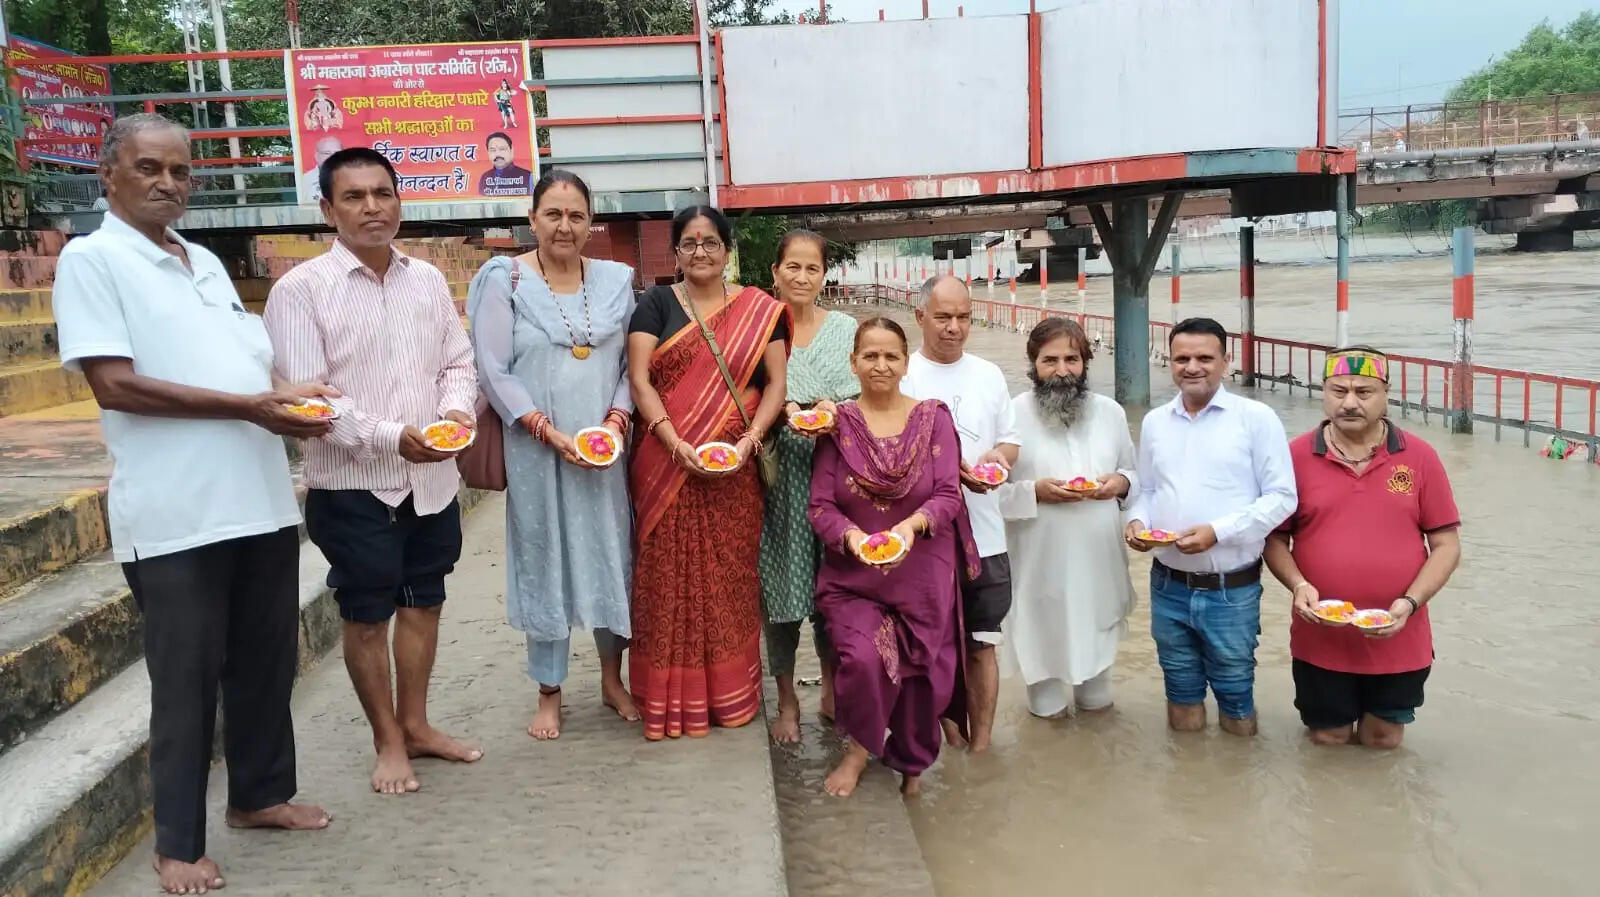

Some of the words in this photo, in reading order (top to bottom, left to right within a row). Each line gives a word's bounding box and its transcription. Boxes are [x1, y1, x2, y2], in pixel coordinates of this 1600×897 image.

[300, 63, 316, 80] श्री
[318, 66, 366, 80] महाराजा
[368, 60, 413, 78] अग्रसेन
[415, 62, 436, 76] घाट
[439, 57, 477, 75] समिति
[480, 55, 518, 78] (रजि.)
[392, 79, 404, 89] की
[341, 96, 375, 115] कुम्भ
[376, 90, 411, 108] नगरी
[413, 90, 456, 109] हरिद्वार
[456, 88, 489, 107] पधारे
[364, 117, 392, 135] सभी
[395, 115, 454, 138] श्रद्धालुओं
[455, 118, 475, 132] का
[409, 145, 461, 162] स्वागत
[464, 144, 476, 160] व
